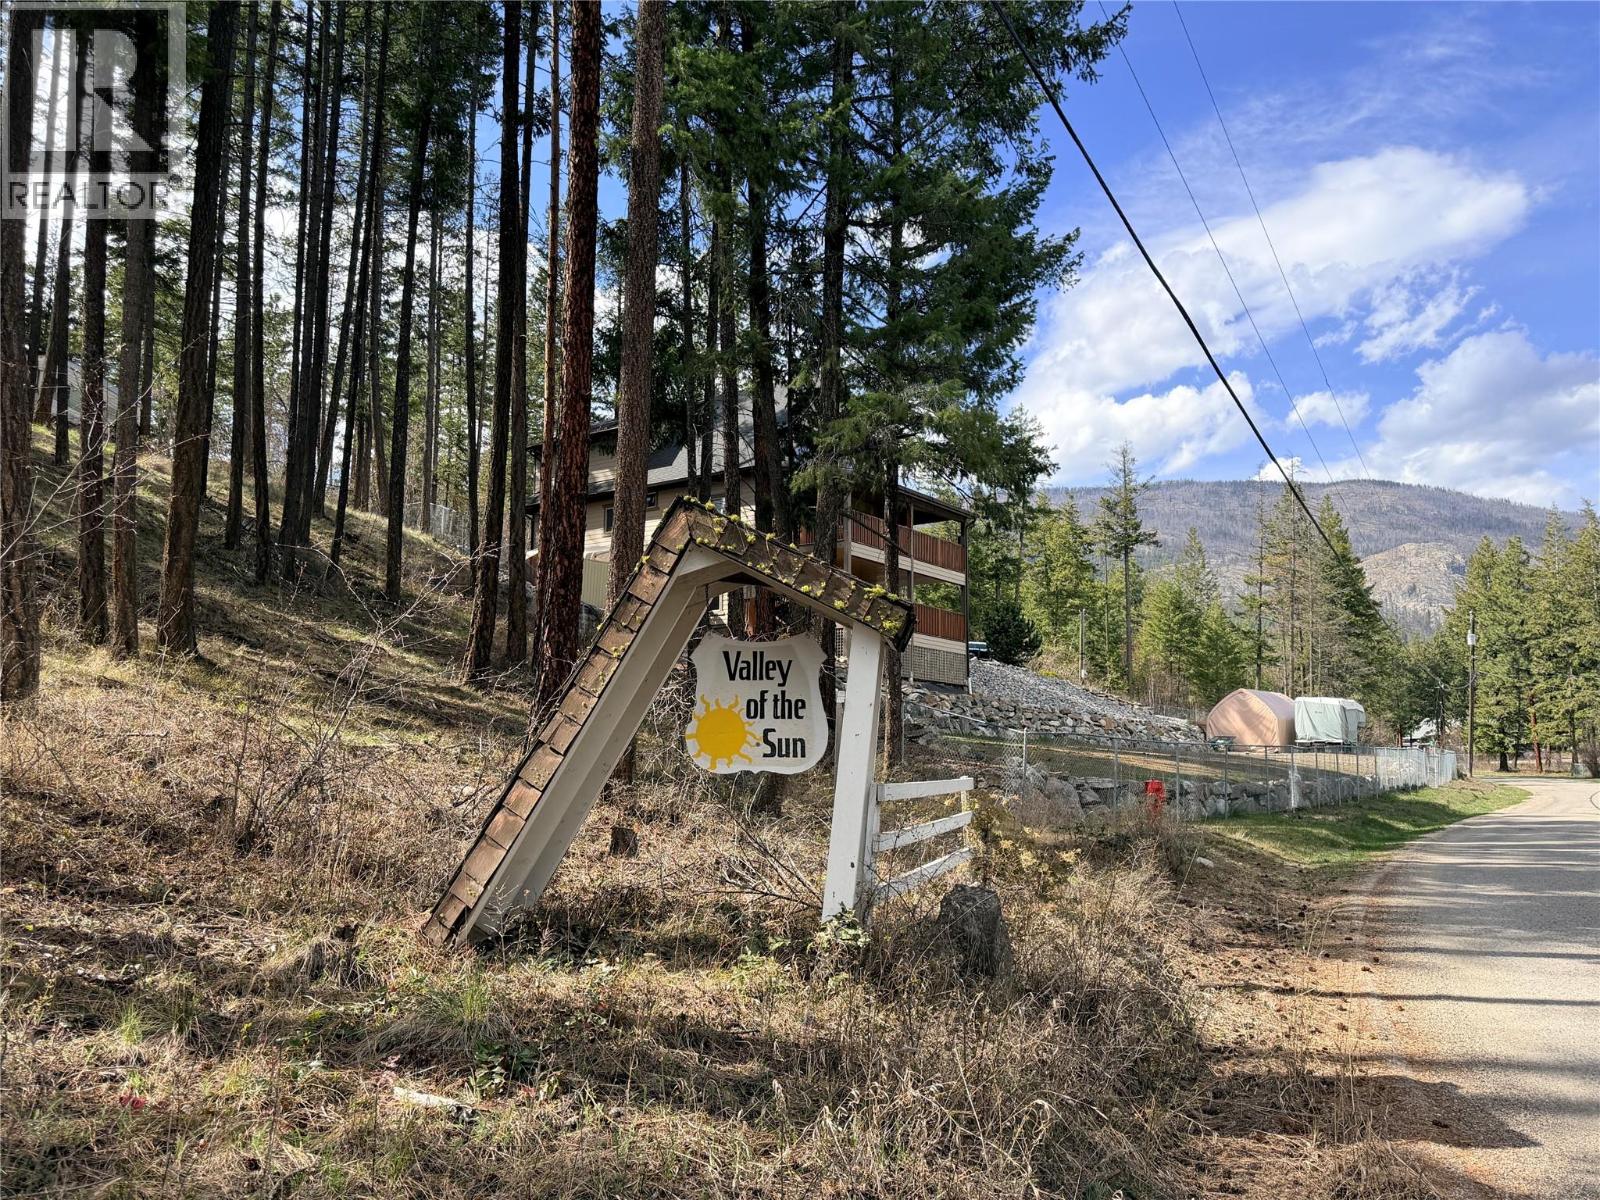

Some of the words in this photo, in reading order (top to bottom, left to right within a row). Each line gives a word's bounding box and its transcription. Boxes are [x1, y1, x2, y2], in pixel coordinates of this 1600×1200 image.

[722, 650, 793, 687] Valley
[745, 689, 769, 720] of
[772, 689, 807, 720] the
[762, 728, 806, 758] Sun
